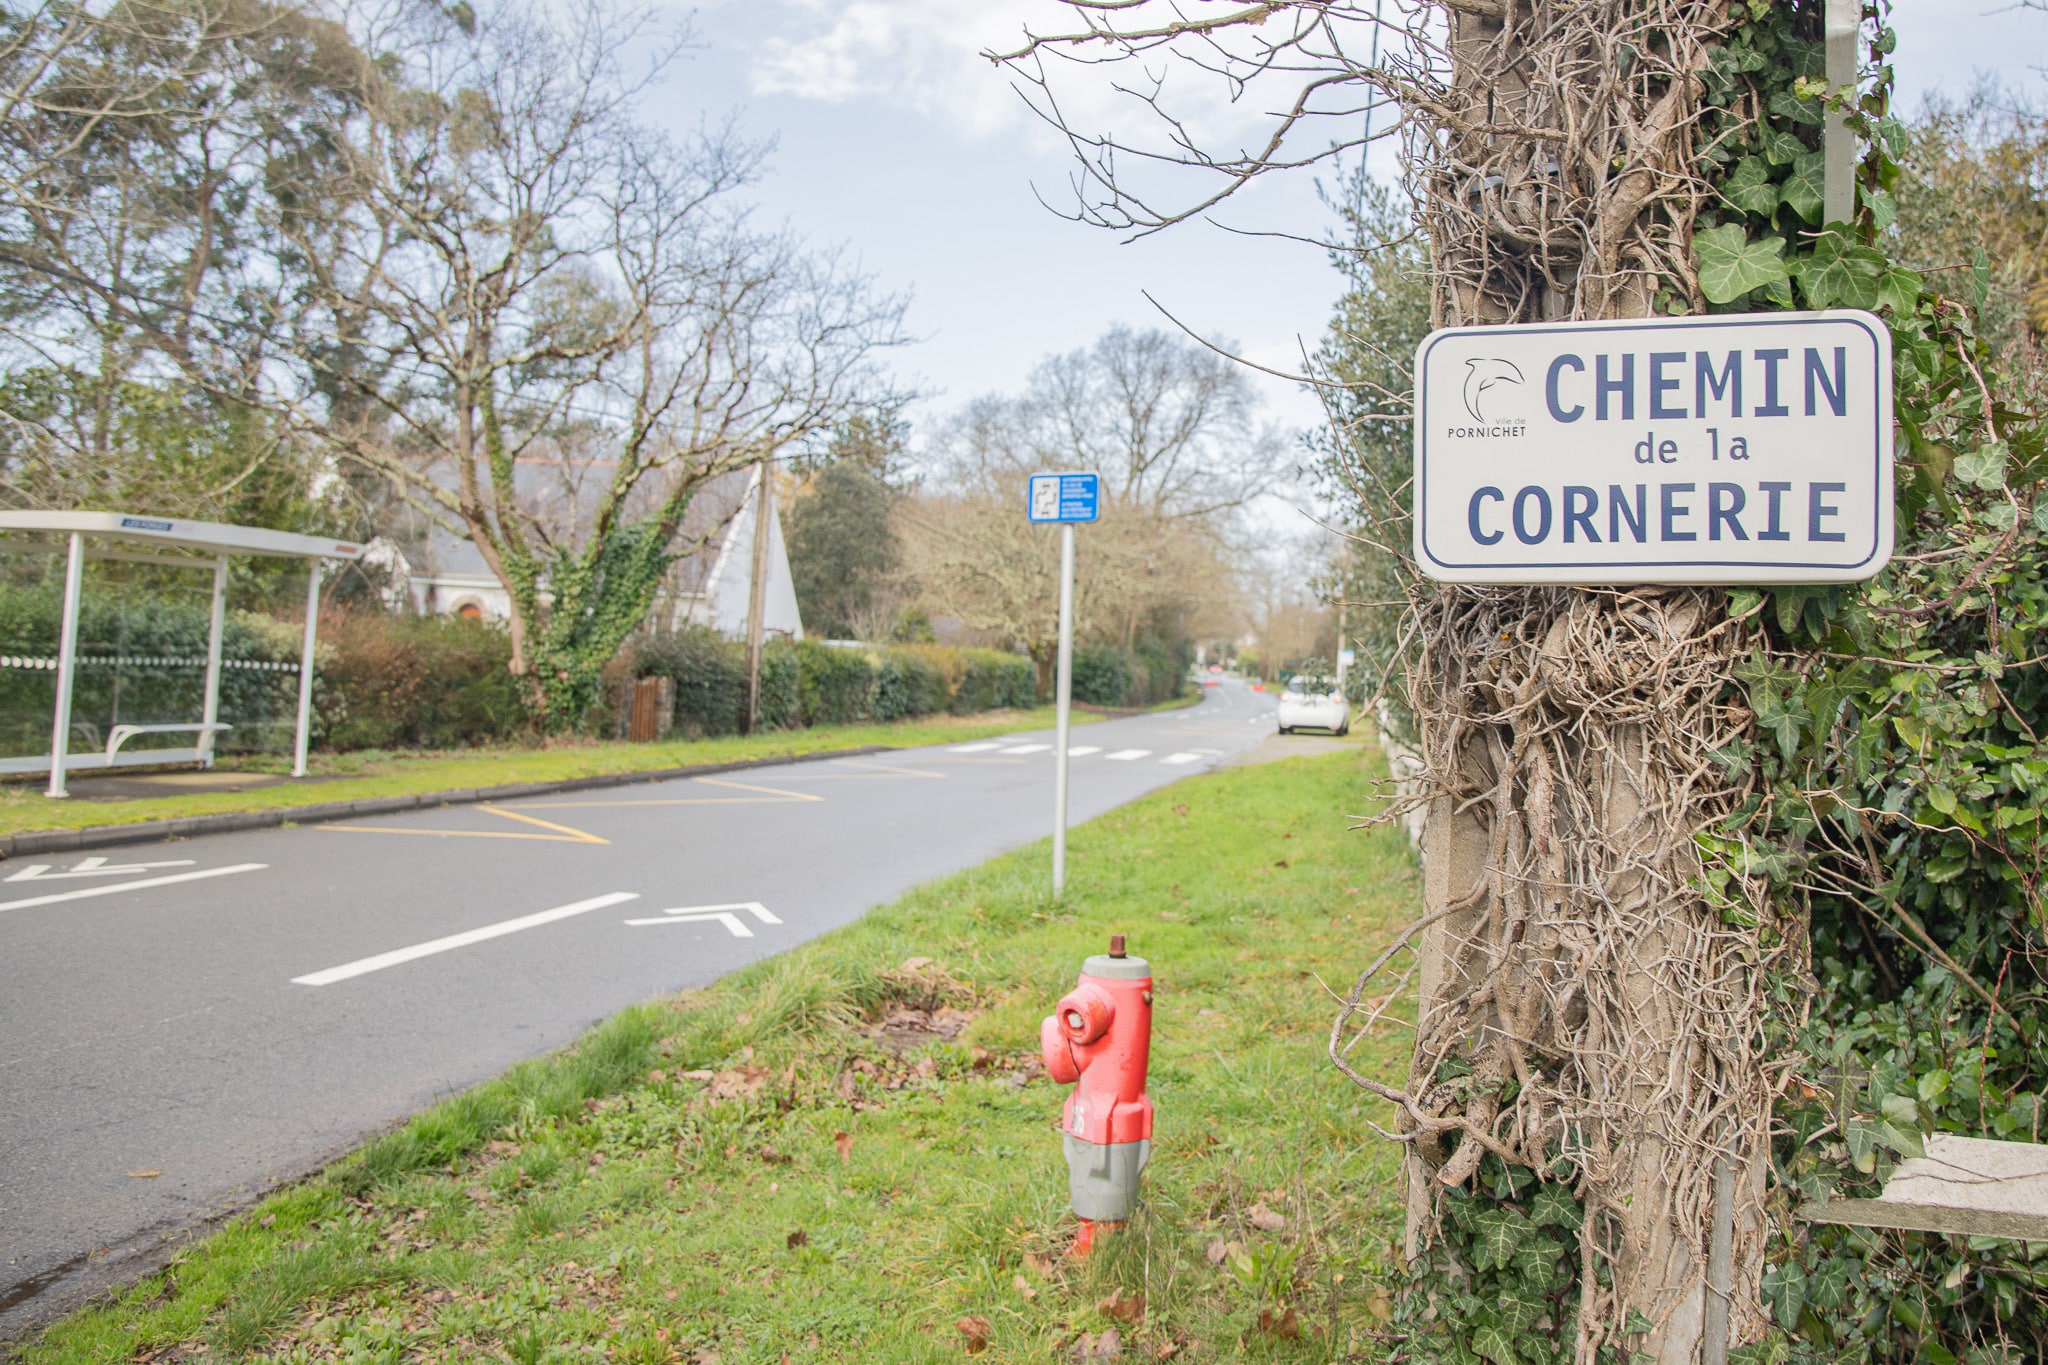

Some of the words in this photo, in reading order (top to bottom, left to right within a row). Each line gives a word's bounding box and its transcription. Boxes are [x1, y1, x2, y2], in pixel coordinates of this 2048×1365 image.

[1545, 346, 1847, 423] CHEMIN
[1448, 426, 1526, 438] PORNICHET
[1495, 417, 1512, 425] Ville
[1514, 417, 1526, 425] de
[1634, 431, 1678, 464] de
[1706, 428, 1750, 461] la
[1467, 482, 1846, 546] CORNERIE
